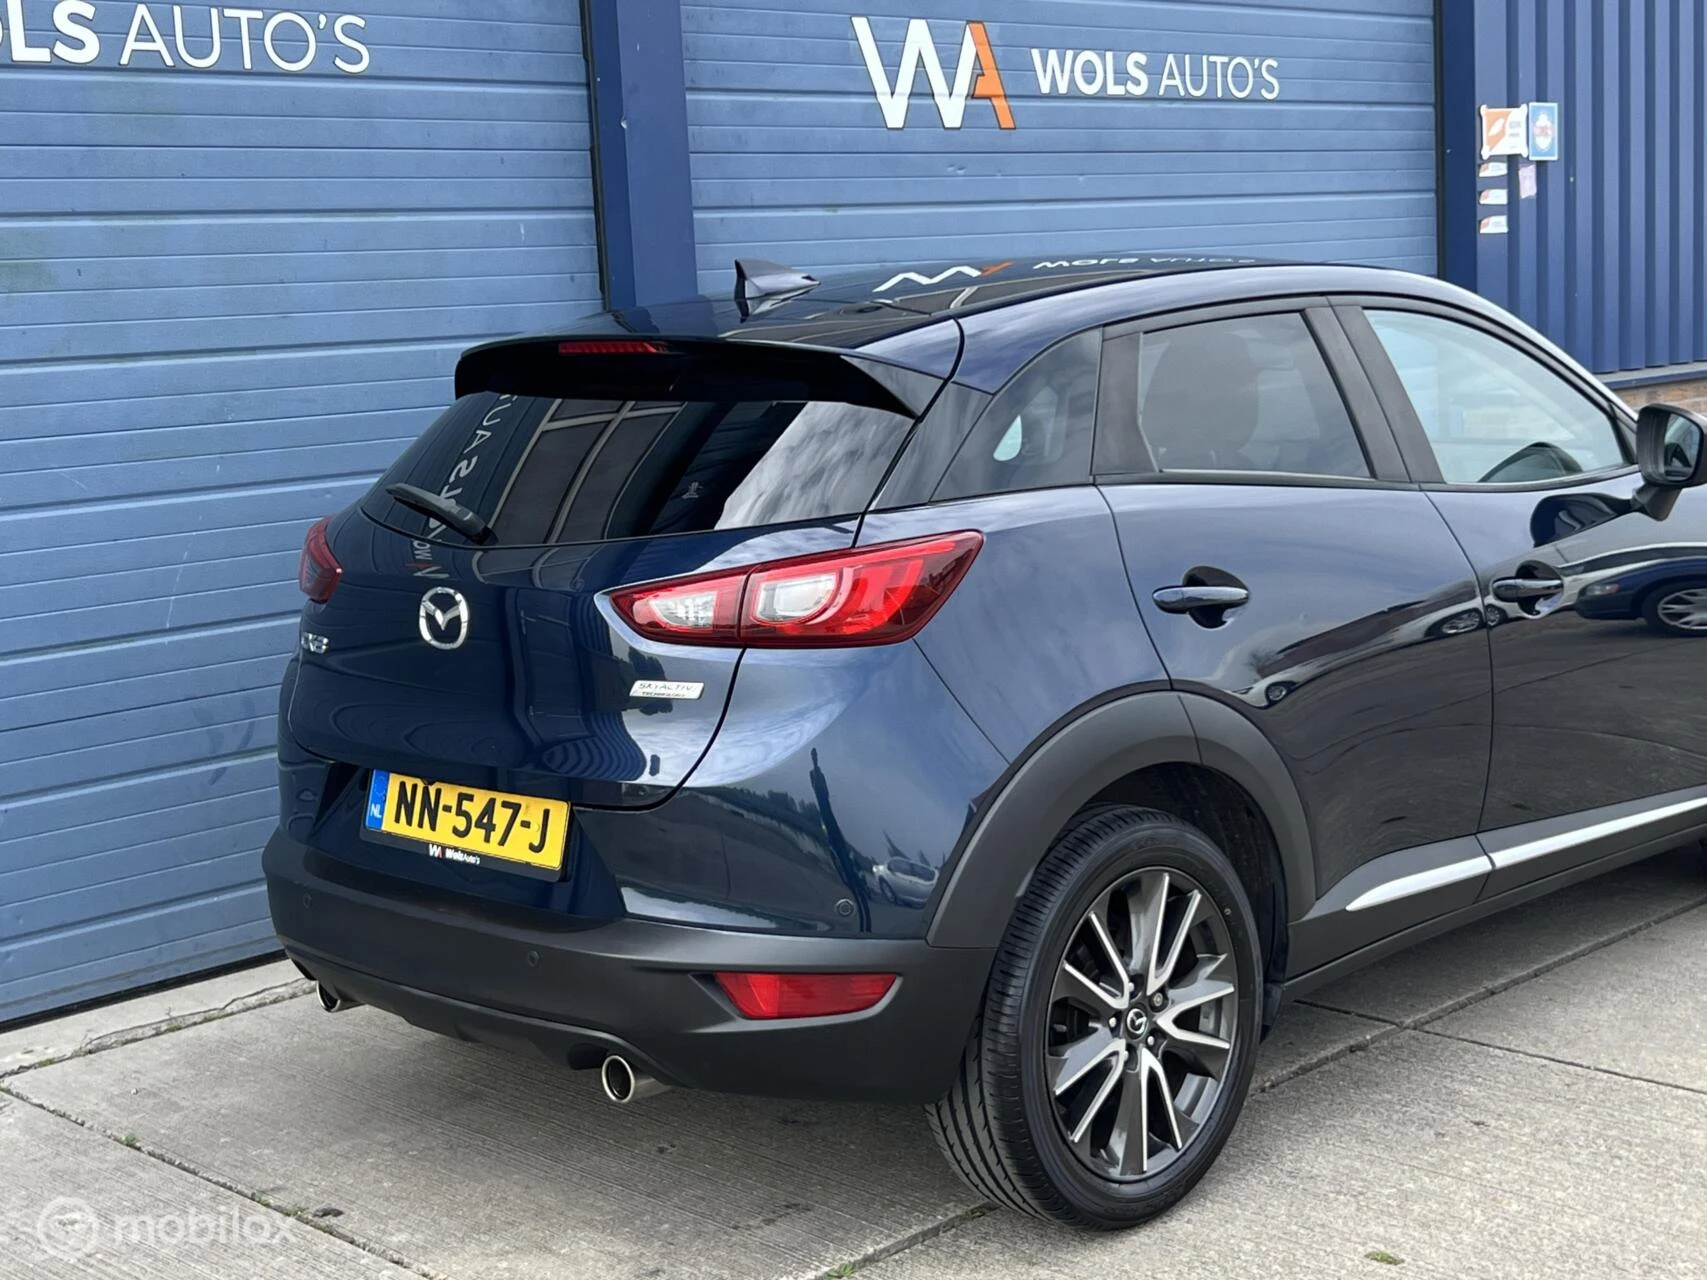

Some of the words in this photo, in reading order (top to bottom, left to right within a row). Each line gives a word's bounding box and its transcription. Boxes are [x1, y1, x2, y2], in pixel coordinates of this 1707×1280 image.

[0, 0, 101, 64] LS
[119, 3, 370, 73] AUTO'S
[1030, 48, 1149, 96] WOLS
[1159, 53, 1280, 100] AUTO'S
[639, 683, 692, 691] SKYACTIV
[370, 803, 382, 818] NL
[394, 781, 550, 854] NN-547-J
